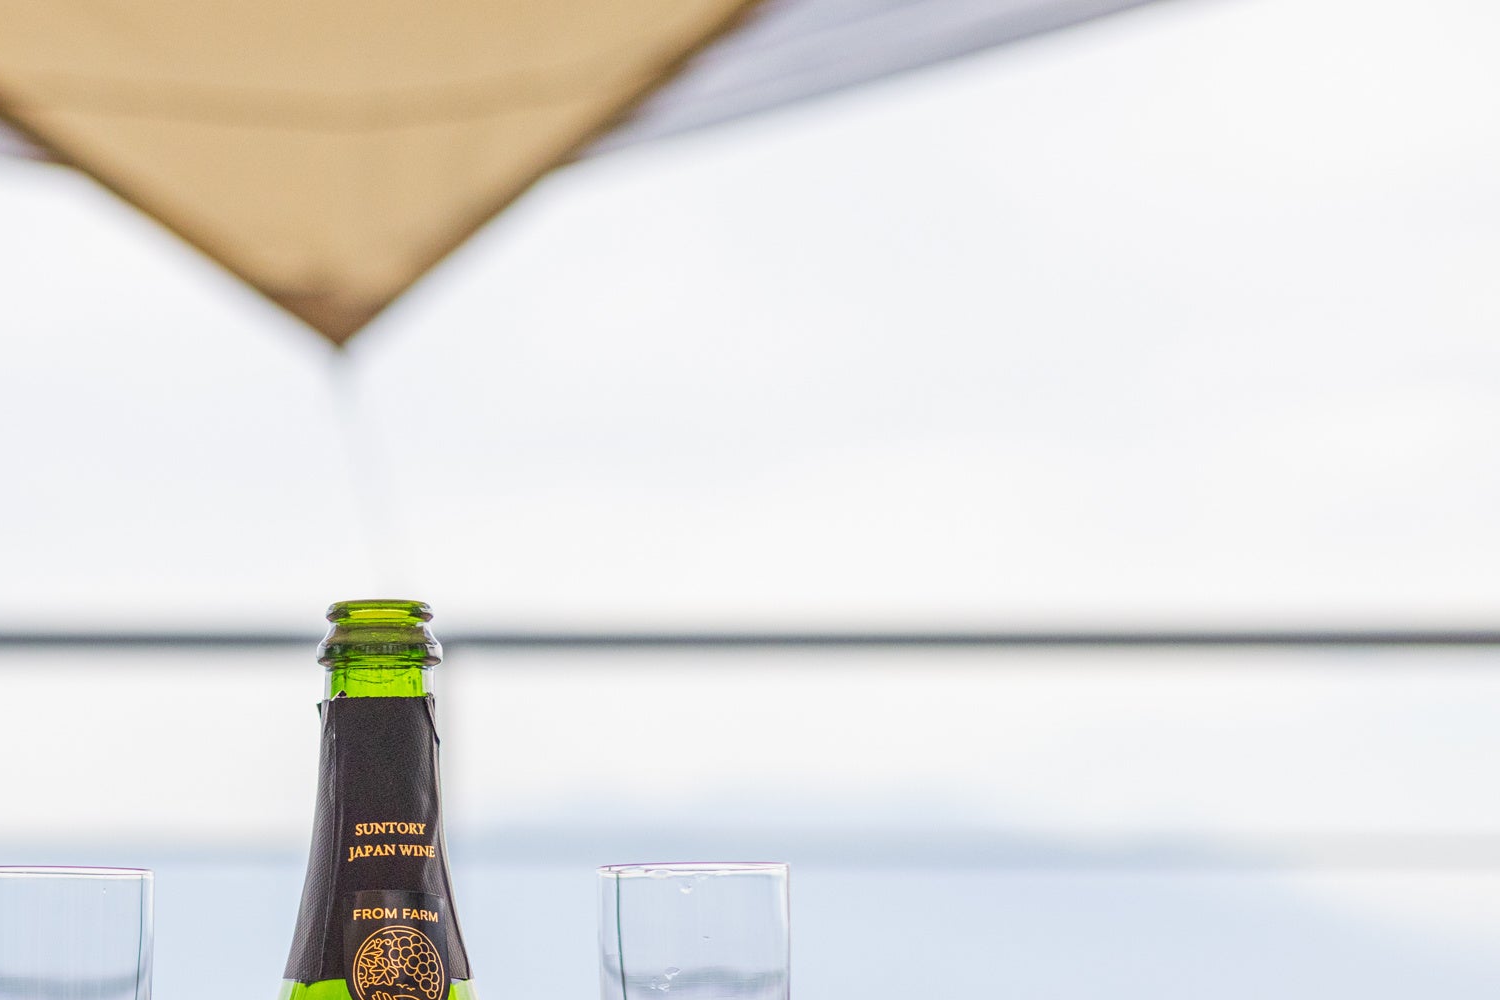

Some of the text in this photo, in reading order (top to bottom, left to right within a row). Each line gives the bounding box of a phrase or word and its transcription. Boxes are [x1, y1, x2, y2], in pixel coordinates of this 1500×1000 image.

[355, 822, 426, 836] SUNTORY
[348, 844, 436, 862] JAPAN WINE
[353, 907, 439, 922] FROM FARM
